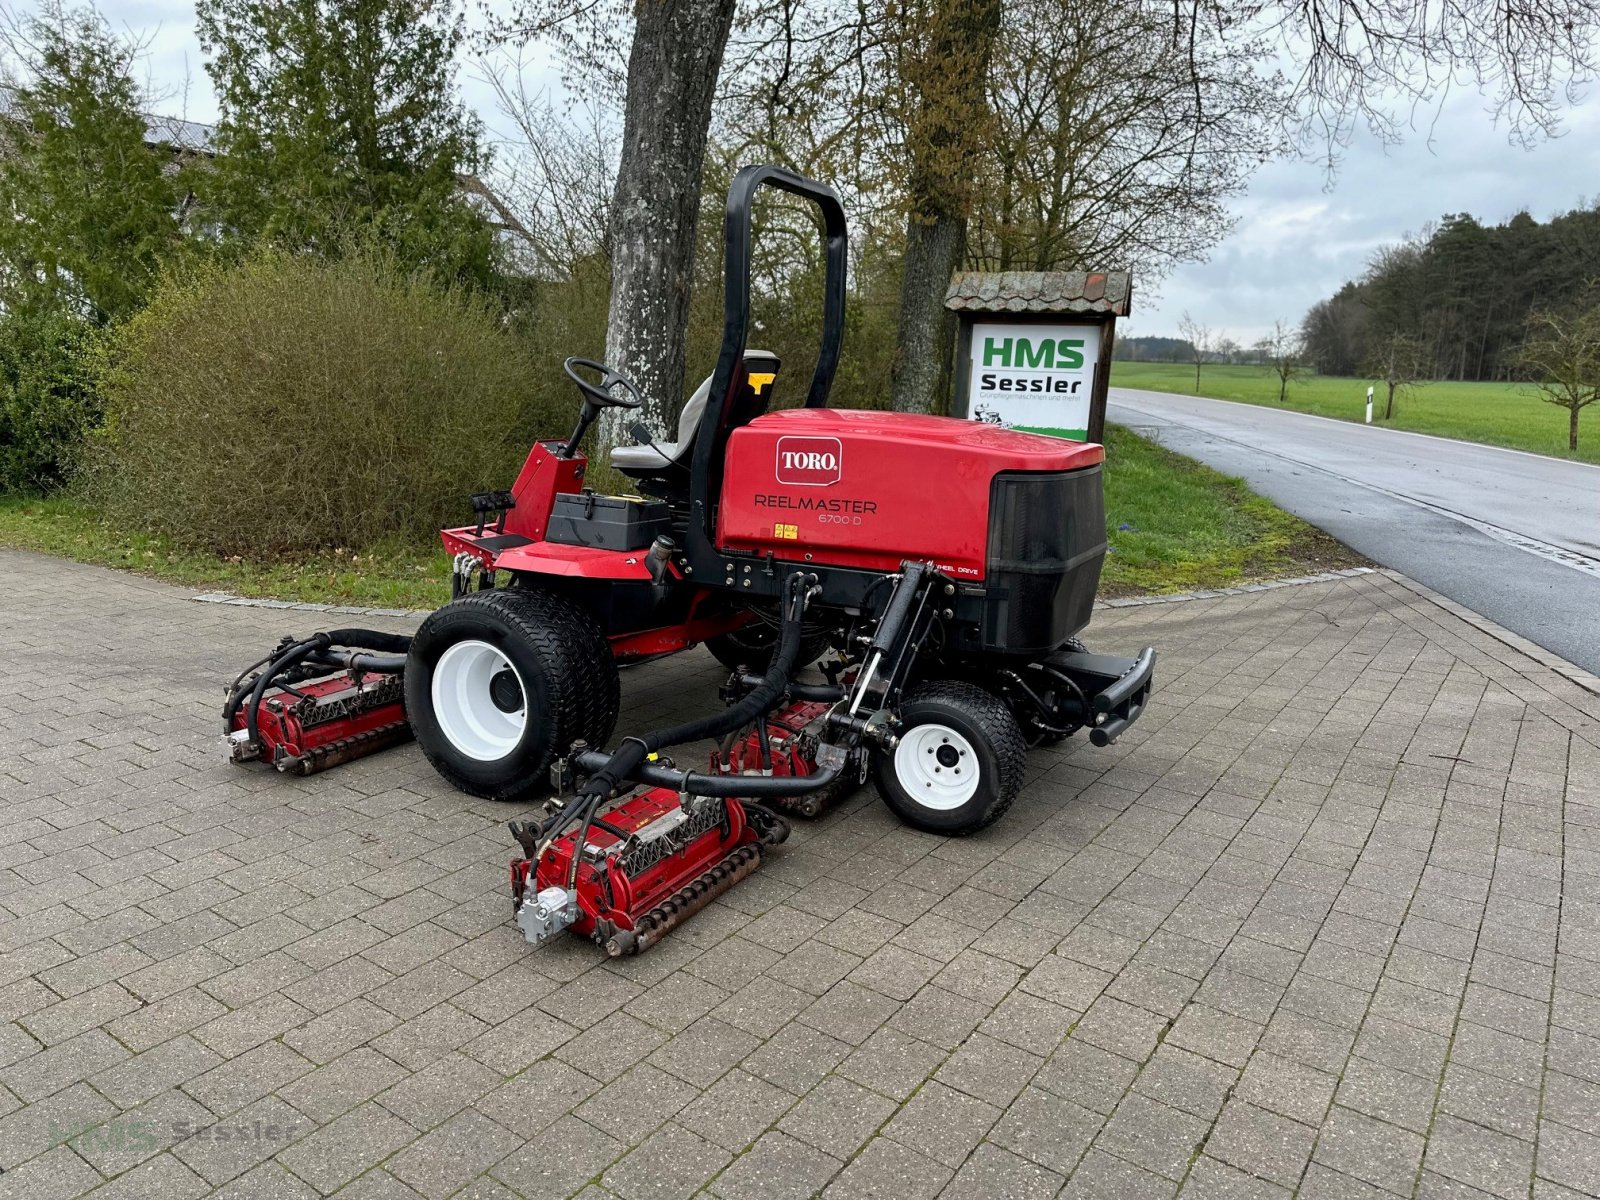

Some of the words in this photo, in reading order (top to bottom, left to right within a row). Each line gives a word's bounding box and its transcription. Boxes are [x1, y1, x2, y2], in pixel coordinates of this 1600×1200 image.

[982, 337, 1085, 369] HMS
[980, 374, 1082, 394] Sessler
[754, 494, 877, 514] REELMASTER
[957, 567, 979, 575] DRIVE
